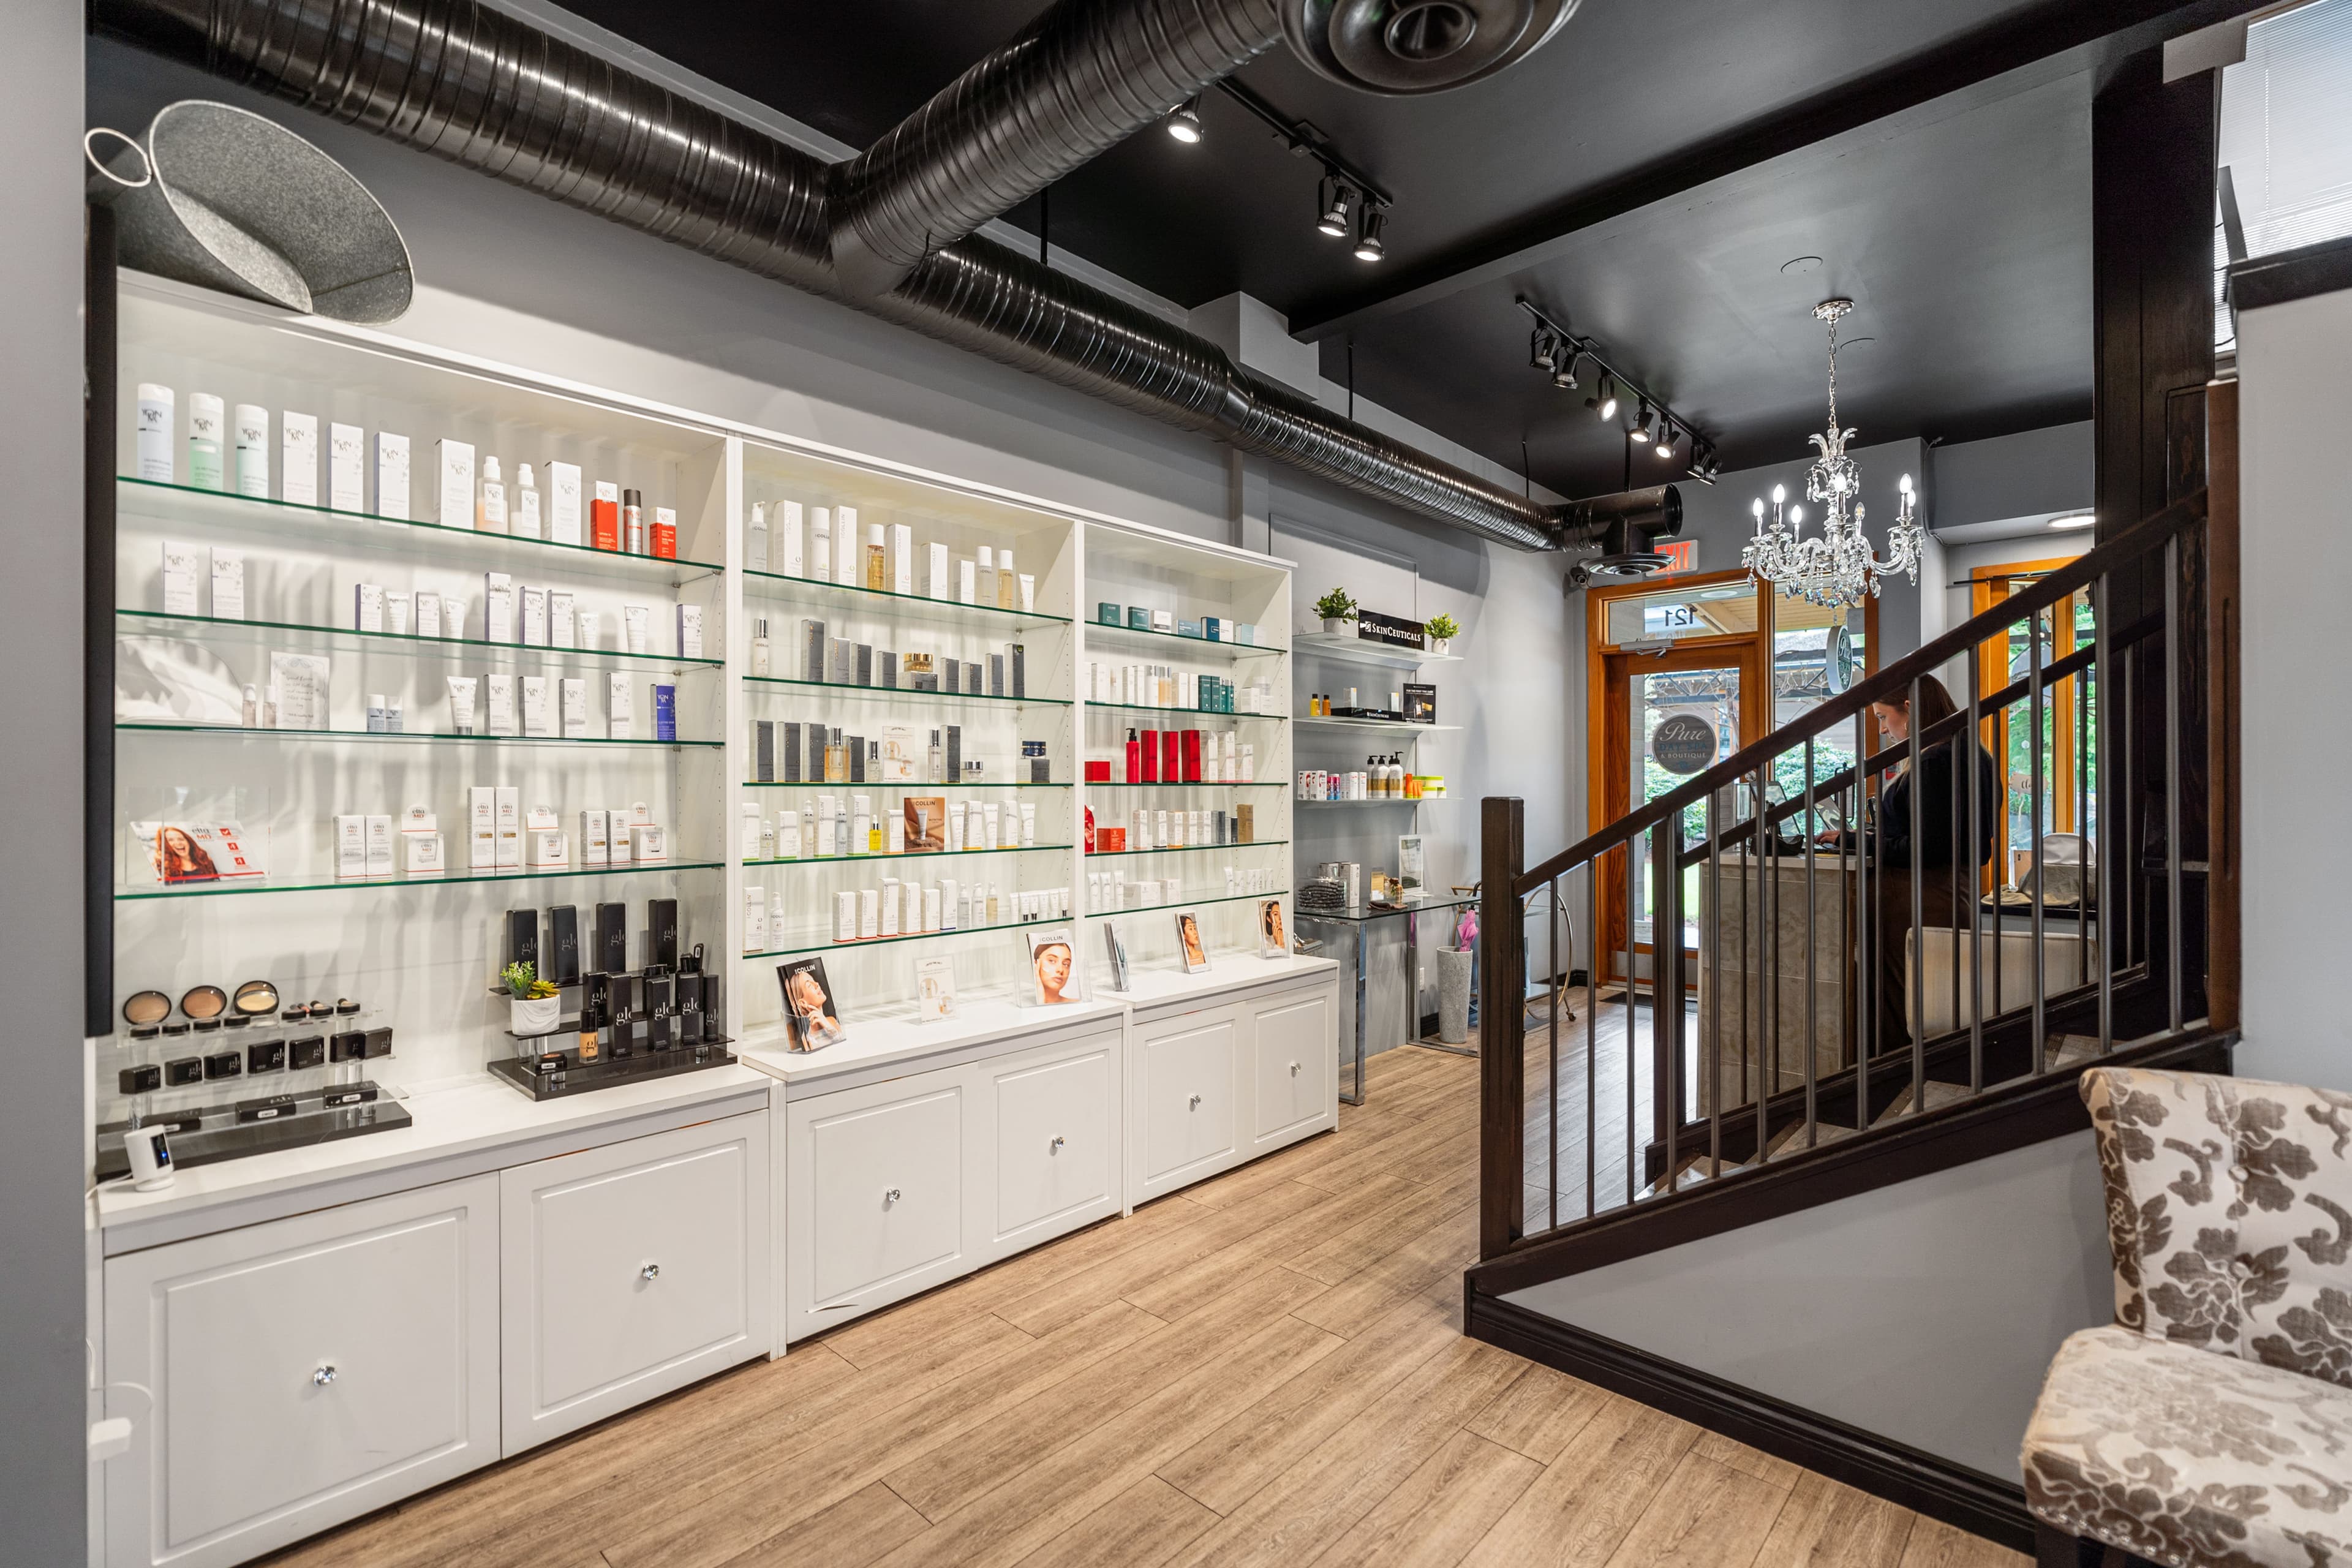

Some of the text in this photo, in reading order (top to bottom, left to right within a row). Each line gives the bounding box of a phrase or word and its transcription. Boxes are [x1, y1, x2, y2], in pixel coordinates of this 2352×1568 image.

[141, 409, 162, 418] YON
[194, 418, 213, 427] YON
[242, 428, 261, 437] YON
[1660, 722, 1706, 741] Pure
[1687, 742, 1706, 750] SPA
[796, 964, 816, 974] COLLIN
[586, 1035, 597, 1053] gl
